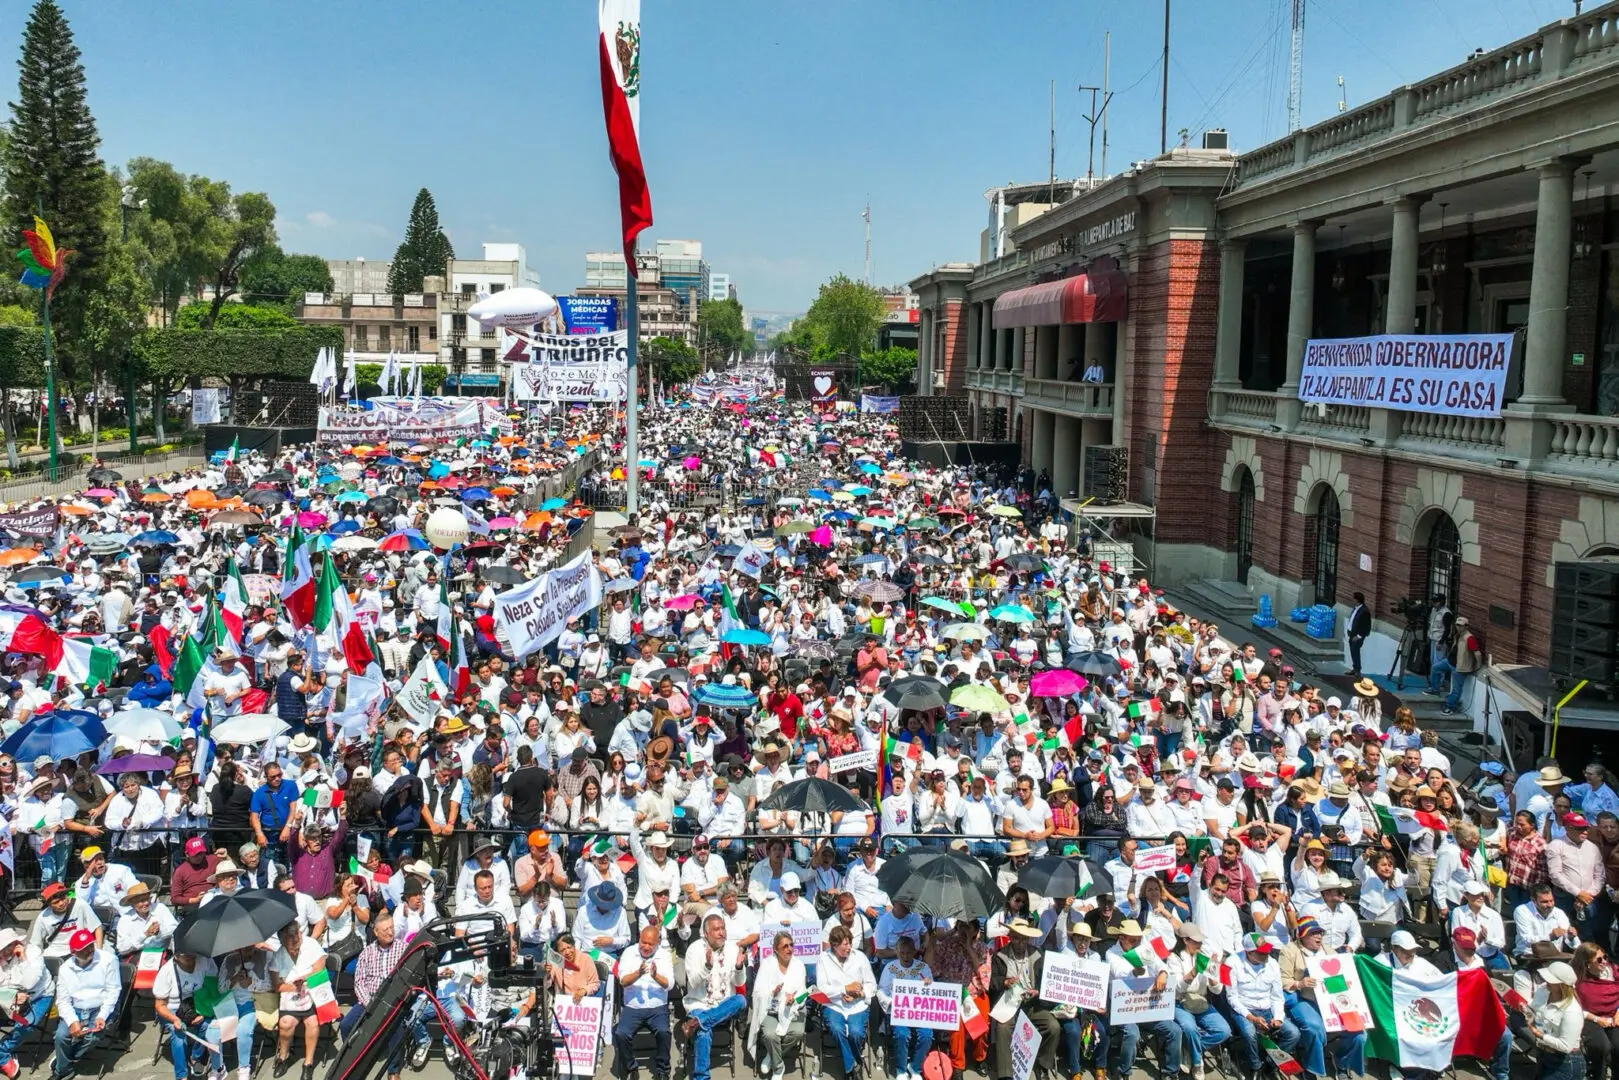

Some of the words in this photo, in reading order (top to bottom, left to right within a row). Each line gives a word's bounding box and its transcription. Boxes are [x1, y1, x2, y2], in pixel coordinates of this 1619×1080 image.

[567, 298, 612, 306] JORNADAS
[571, 305, 608, 313] MÉDICAS
[503, 328, 531, 362] 2
[1306, 341, 1373, 367] BIENVENIDA
[1375, 341, 1505, 370] GOBERNADORA
[1301, 375, 1385, 401] TLALNEPANTLA
[1389, 377, 1414, 403] ES
[1417, 379, 1443, 406] SU
[1445, 380, 1495, 411] CASA
[502, 601, 534, 625] Neza
[533, 591, 550, 609] con
[526, 608, 556, 640] Claudia
[791, 927, 820, 936] honor
[1050, 965, 1070, 975] Claudia
[1063, 975, 1070, 983] de
[895, 985, 907, 994] ¡SE
[907, 986, 920, 995] VE,
[921, 987, 930, 996] SE
[931, 988, 959, 999] SIENTE,
[1063, 984, 1083, 995] fuerza
[1084, 988, 1095, 997] del
[894, 994, 910, 1009] LA
[912, 996, 957, 1012] PATRIA
[1045, 989, 1067, 1001] Estado
[1067, 994, 1077, 1003] de
[1077, 995, 1101, 1008] México
[556, 1004, 564, 1020] 2
[893, 1009, 905, 1019] SE
[907, 1010, 957, 1024] DEFIENDE!
